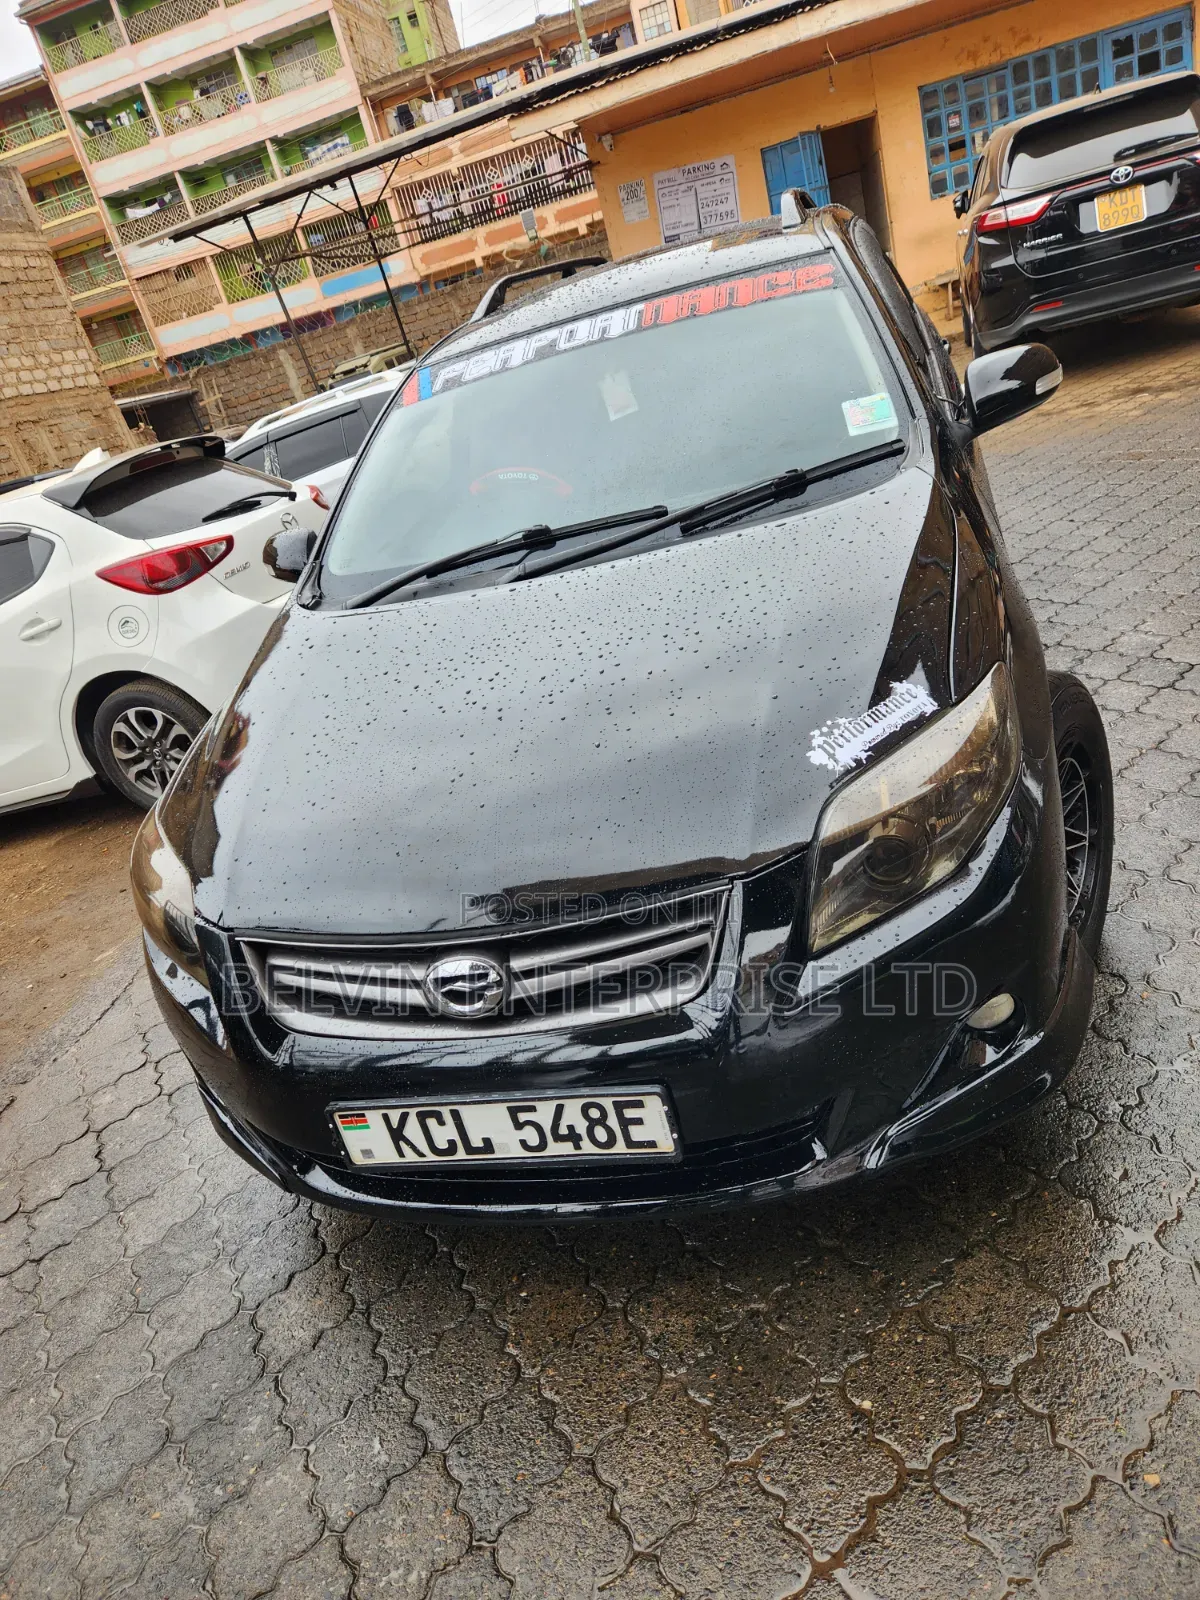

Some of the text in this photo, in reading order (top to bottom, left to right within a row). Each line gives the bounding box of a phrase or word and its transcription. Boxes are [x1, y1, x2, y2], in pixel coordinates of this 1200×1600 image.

[682, 162, 716, 176] PARKING
[618, 180, 644, 194] PARKING
[701, 197, 729, 209] 247247
[1109, 187, 1138, 208] KDT
[703, 209, 735, 224] 377595
[1023, 233, 1063, 248] HARRIER
[900, 701, 928, 724] TOYOTA
[381, 1108, 495, 1158] KCL
[506, 1099, 658, 1153] 548E
